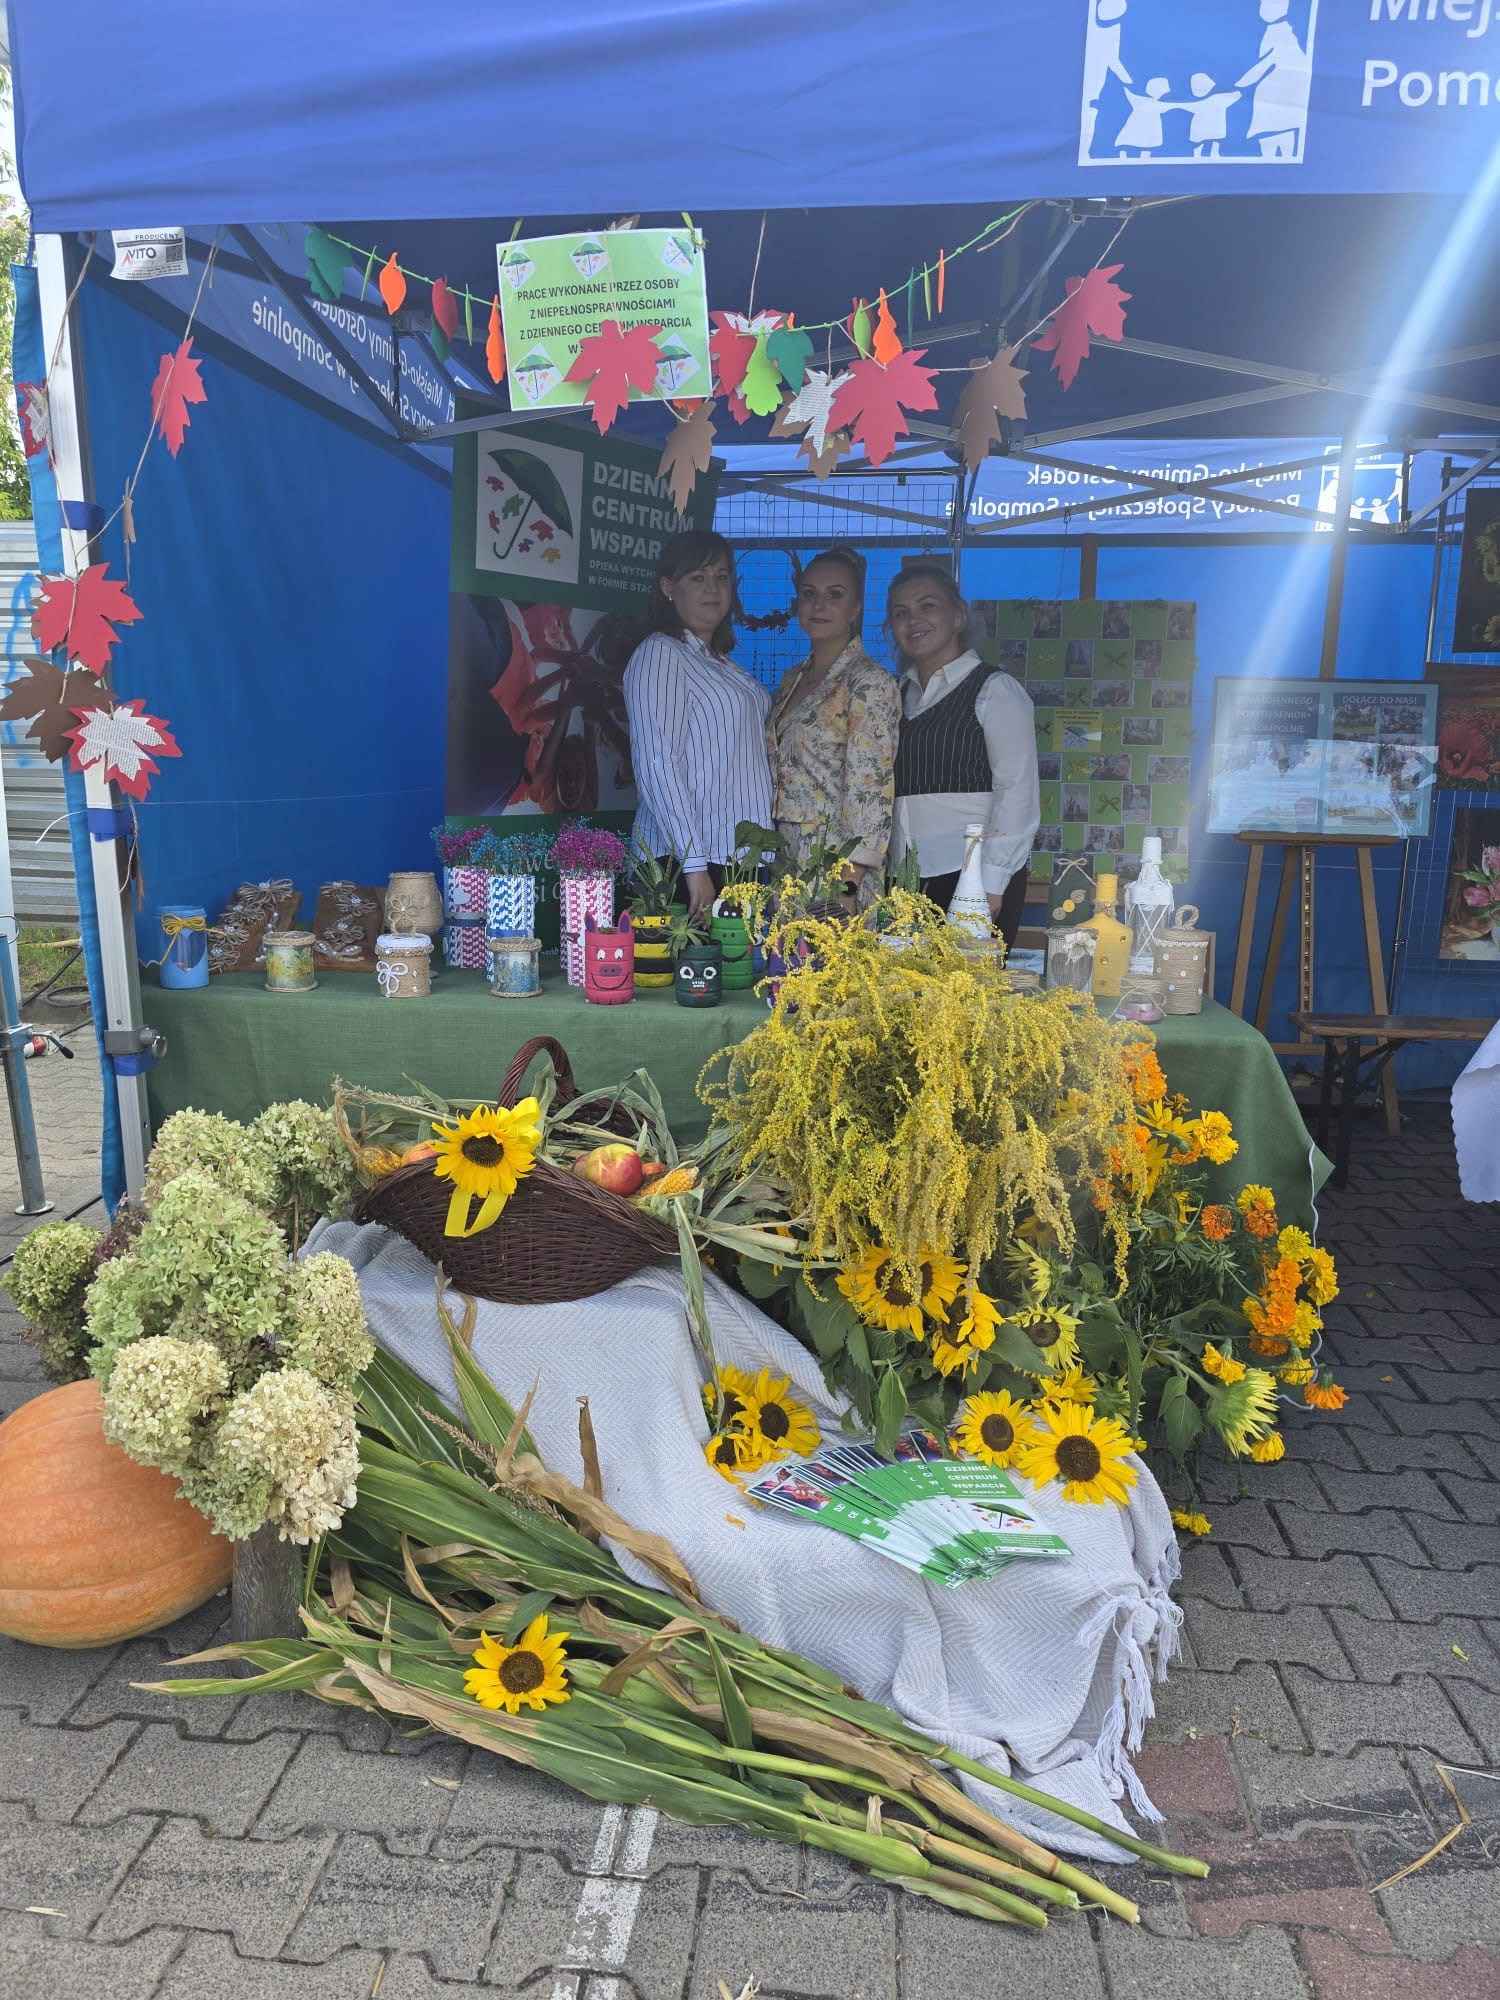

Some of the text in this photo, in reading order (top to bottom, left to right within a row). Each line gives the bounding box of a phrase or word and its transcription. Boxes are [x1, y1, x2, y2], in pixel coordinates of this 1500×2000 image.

[1361, 59, 1500, 107] Pom
[135, 233, 179, 241] PRODUCENT
[517, 278, 680, 301] PRACE WYKONANE PRZEZ OSOBY
[530, 298, 676, 320] Z NIEPEŁNOSPRAWNOŚCIAMI
[519, 330, 526, 340] Z
[527, 324, 582, 340] DZIENNEGO
[568, 344, 578, 355] W
[593, 461, 675, 501] DZIENN
[592, 495, 695, 534] CENTRUM
[590, 527, 661, 560] WSPAR
[589, 559, 619, 573] OPIEKA
[630, 583, 653, 593] STAC
[1342, 695, 1417, 705] DOŁĄCZ DO NAS!
